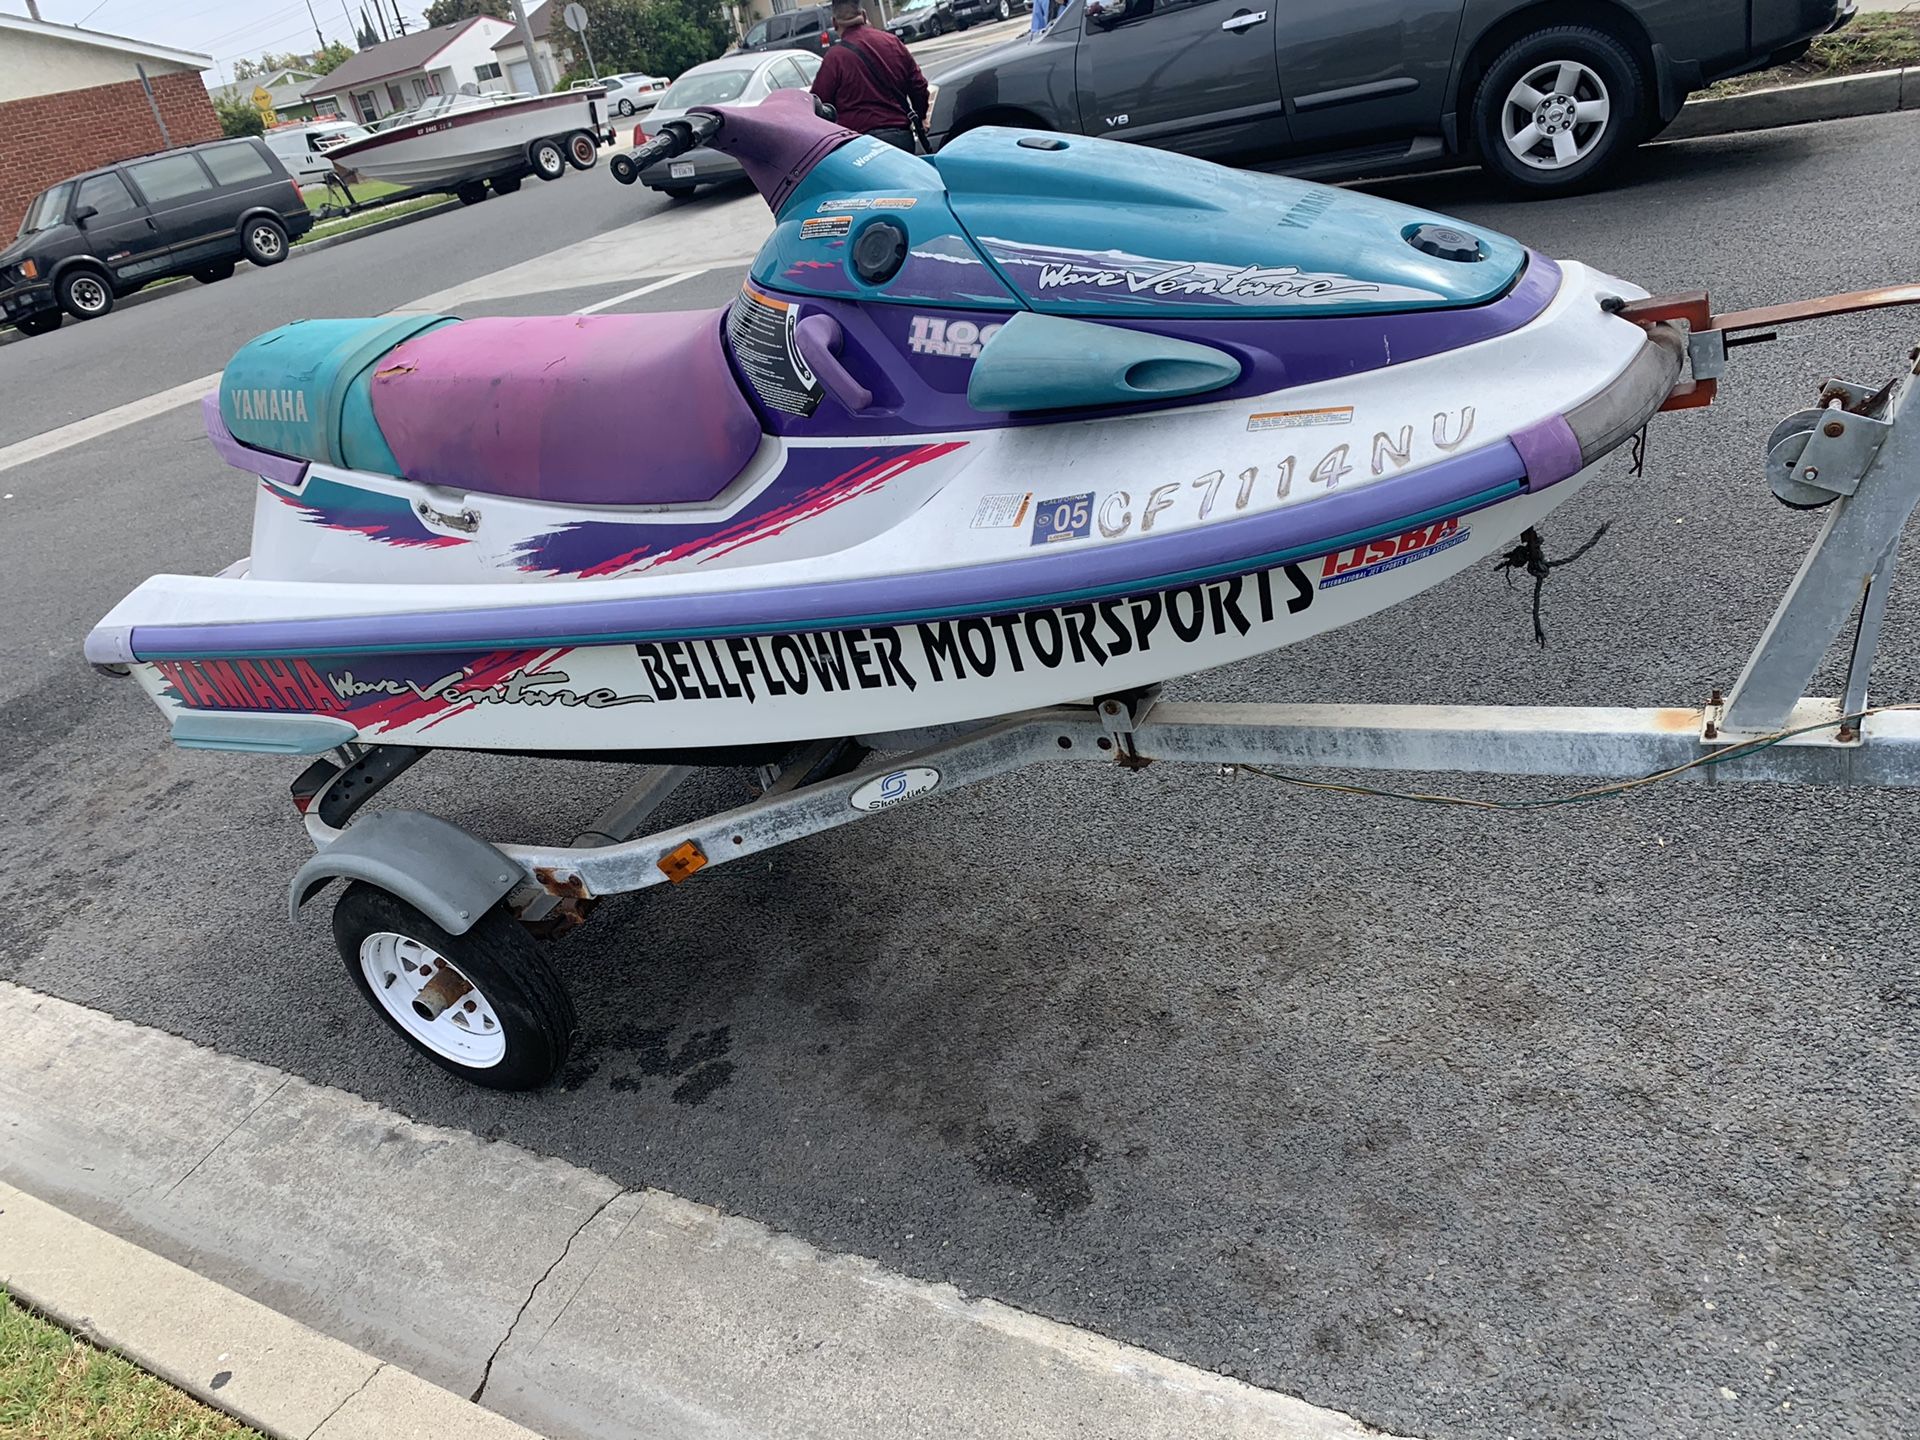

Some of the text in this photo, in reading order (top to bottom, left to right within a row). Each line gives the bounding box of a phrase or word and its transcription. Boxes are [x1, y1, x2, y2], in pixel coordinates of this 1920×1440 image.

[263, 111, 274, 122] 15
[1105, 114, 1129, 127] V8
[1126, 264, 1379, 298] Venture
[231, 389, 309, 422] YAMAHA
[1043, 493, 1088, 506] CALIFORNIA
[1053, 501, 1088, 532] 05
[1320, 534, 1468, 589] INTERNATIONAL JET SPORTS BOATING ASSOCIATION
[1322, 517, 1461, 578] IJSBA
[636, 562, 1315, 704] BELLFLOWER MOTORSPORTS
[152, 659, 346, 711] YAMAHA
[327, 669, 654, 709] Wave Venture
[868, 785, 927, 810] Shoreline
